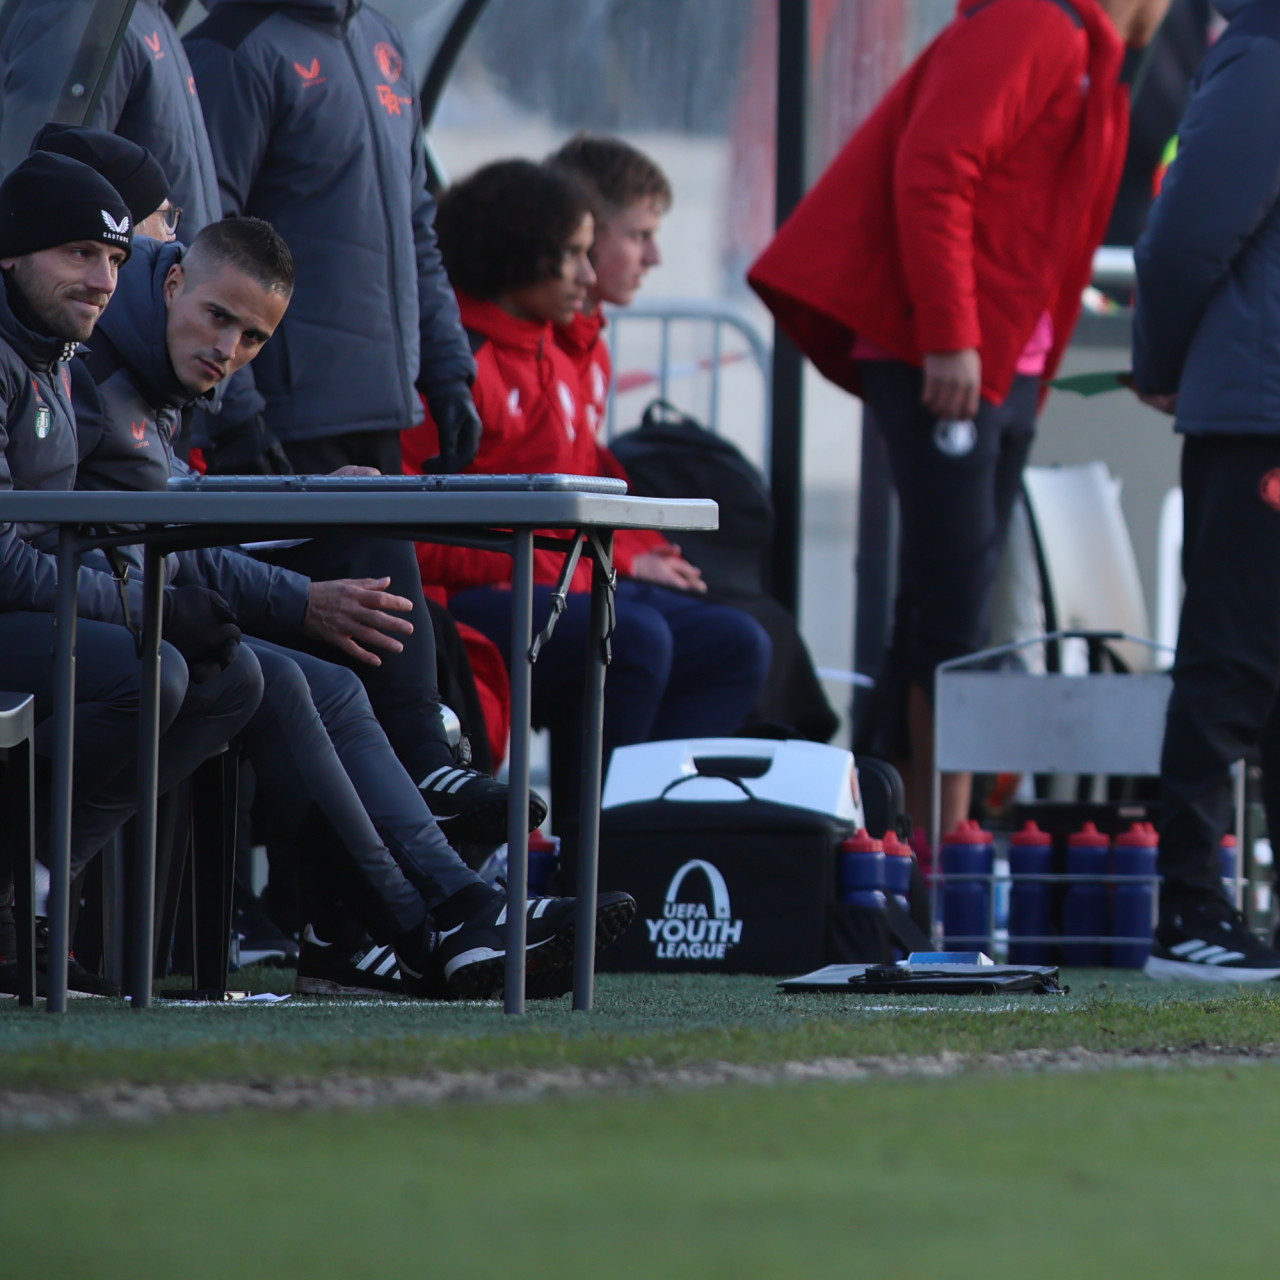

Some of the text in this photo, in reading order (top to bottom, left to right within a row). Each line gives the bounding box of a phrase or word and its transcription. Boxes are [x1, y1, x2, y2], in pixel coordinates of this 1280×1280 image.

[663, 902, 709, 919] UEFA
[645, 918, 744, 943] YOUTH
[655, 941, 726, 959] LEAGUE
